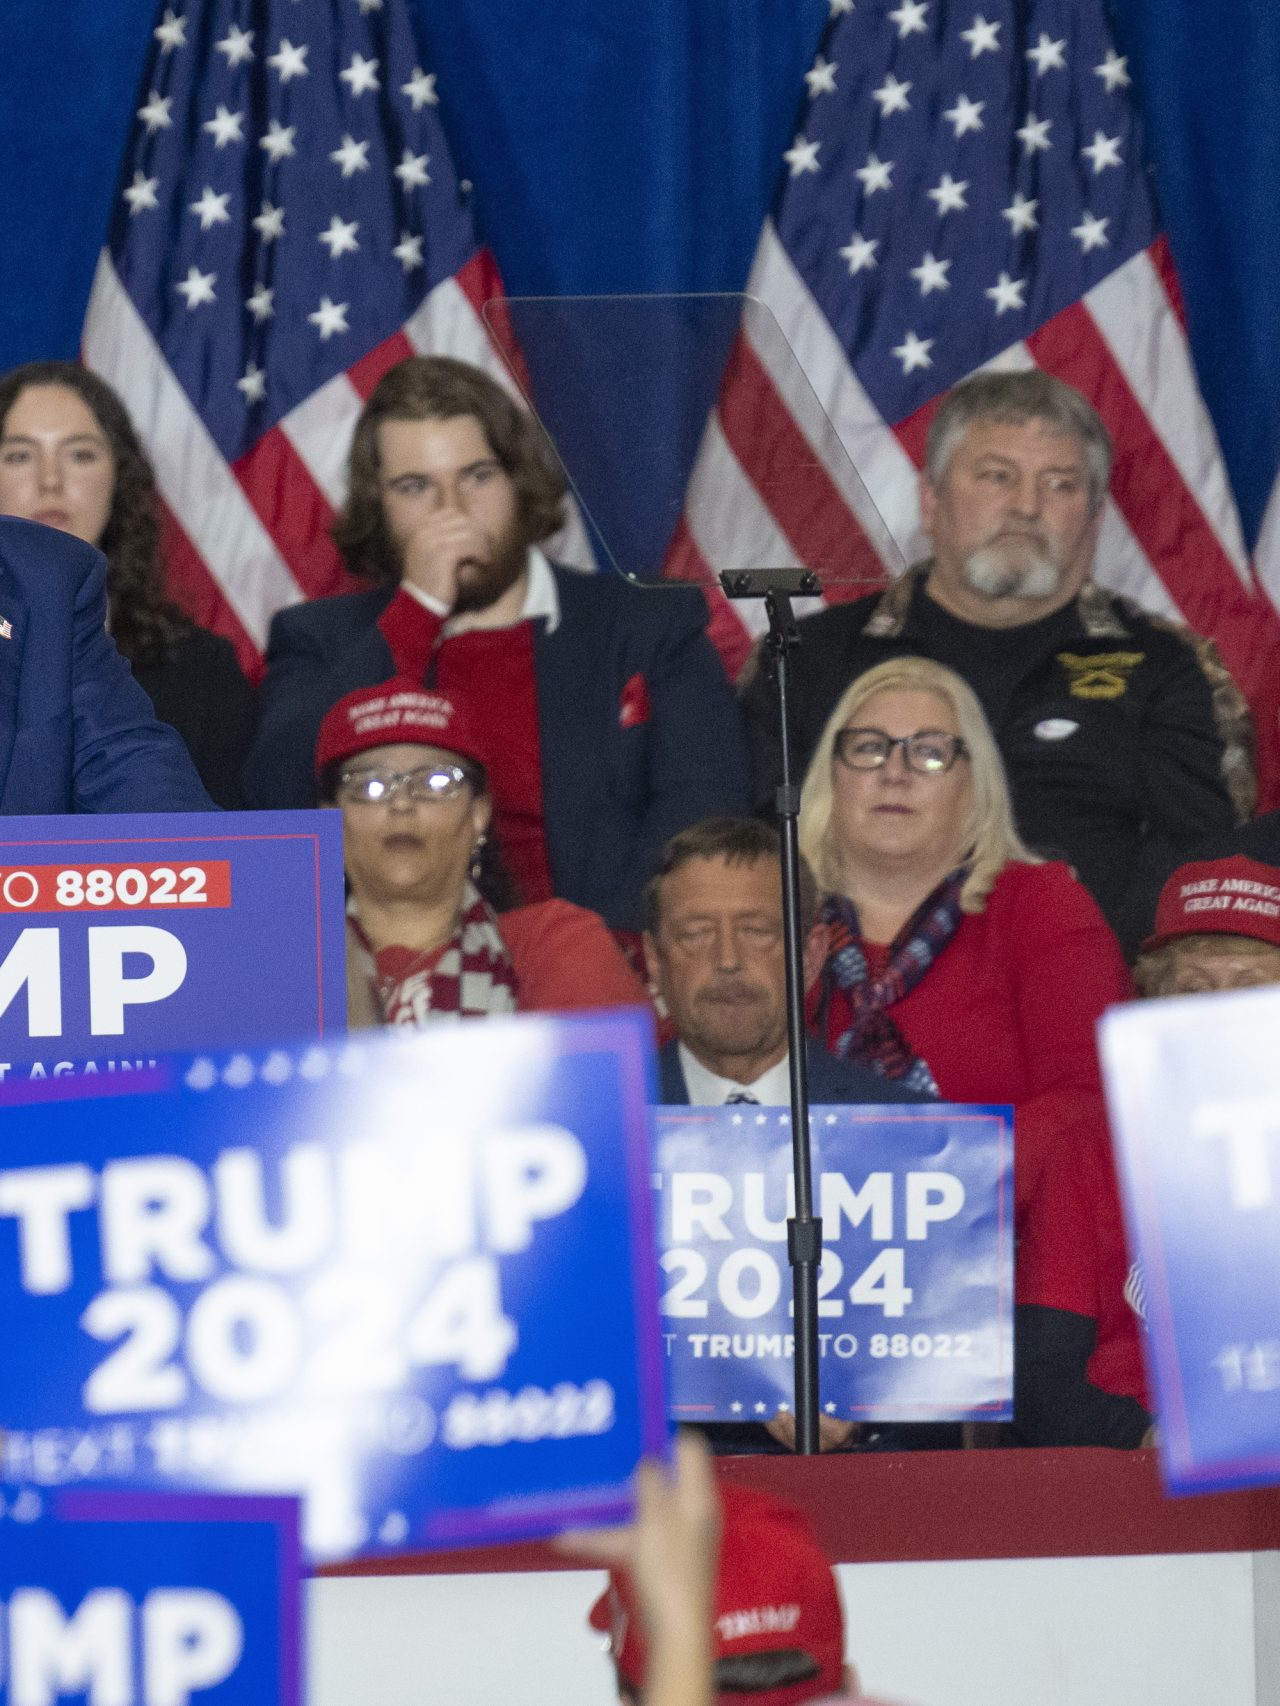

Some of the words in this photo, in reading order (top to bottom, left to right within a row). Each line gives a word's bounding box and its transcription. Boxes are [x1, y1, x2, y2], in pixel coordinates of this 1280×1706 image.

[55, 867, 208, 907] 88022
[1180, 878, 1219, 899] MAKE
[1219, 878, 1280, 902] AMERIC
[1184, 896, 1232, 914] GREAT
[652, 1172, 966, 1242] RUMP
[818, 1333, 858, 1359] TO
[870, 1333, 972, 1359] 88022
